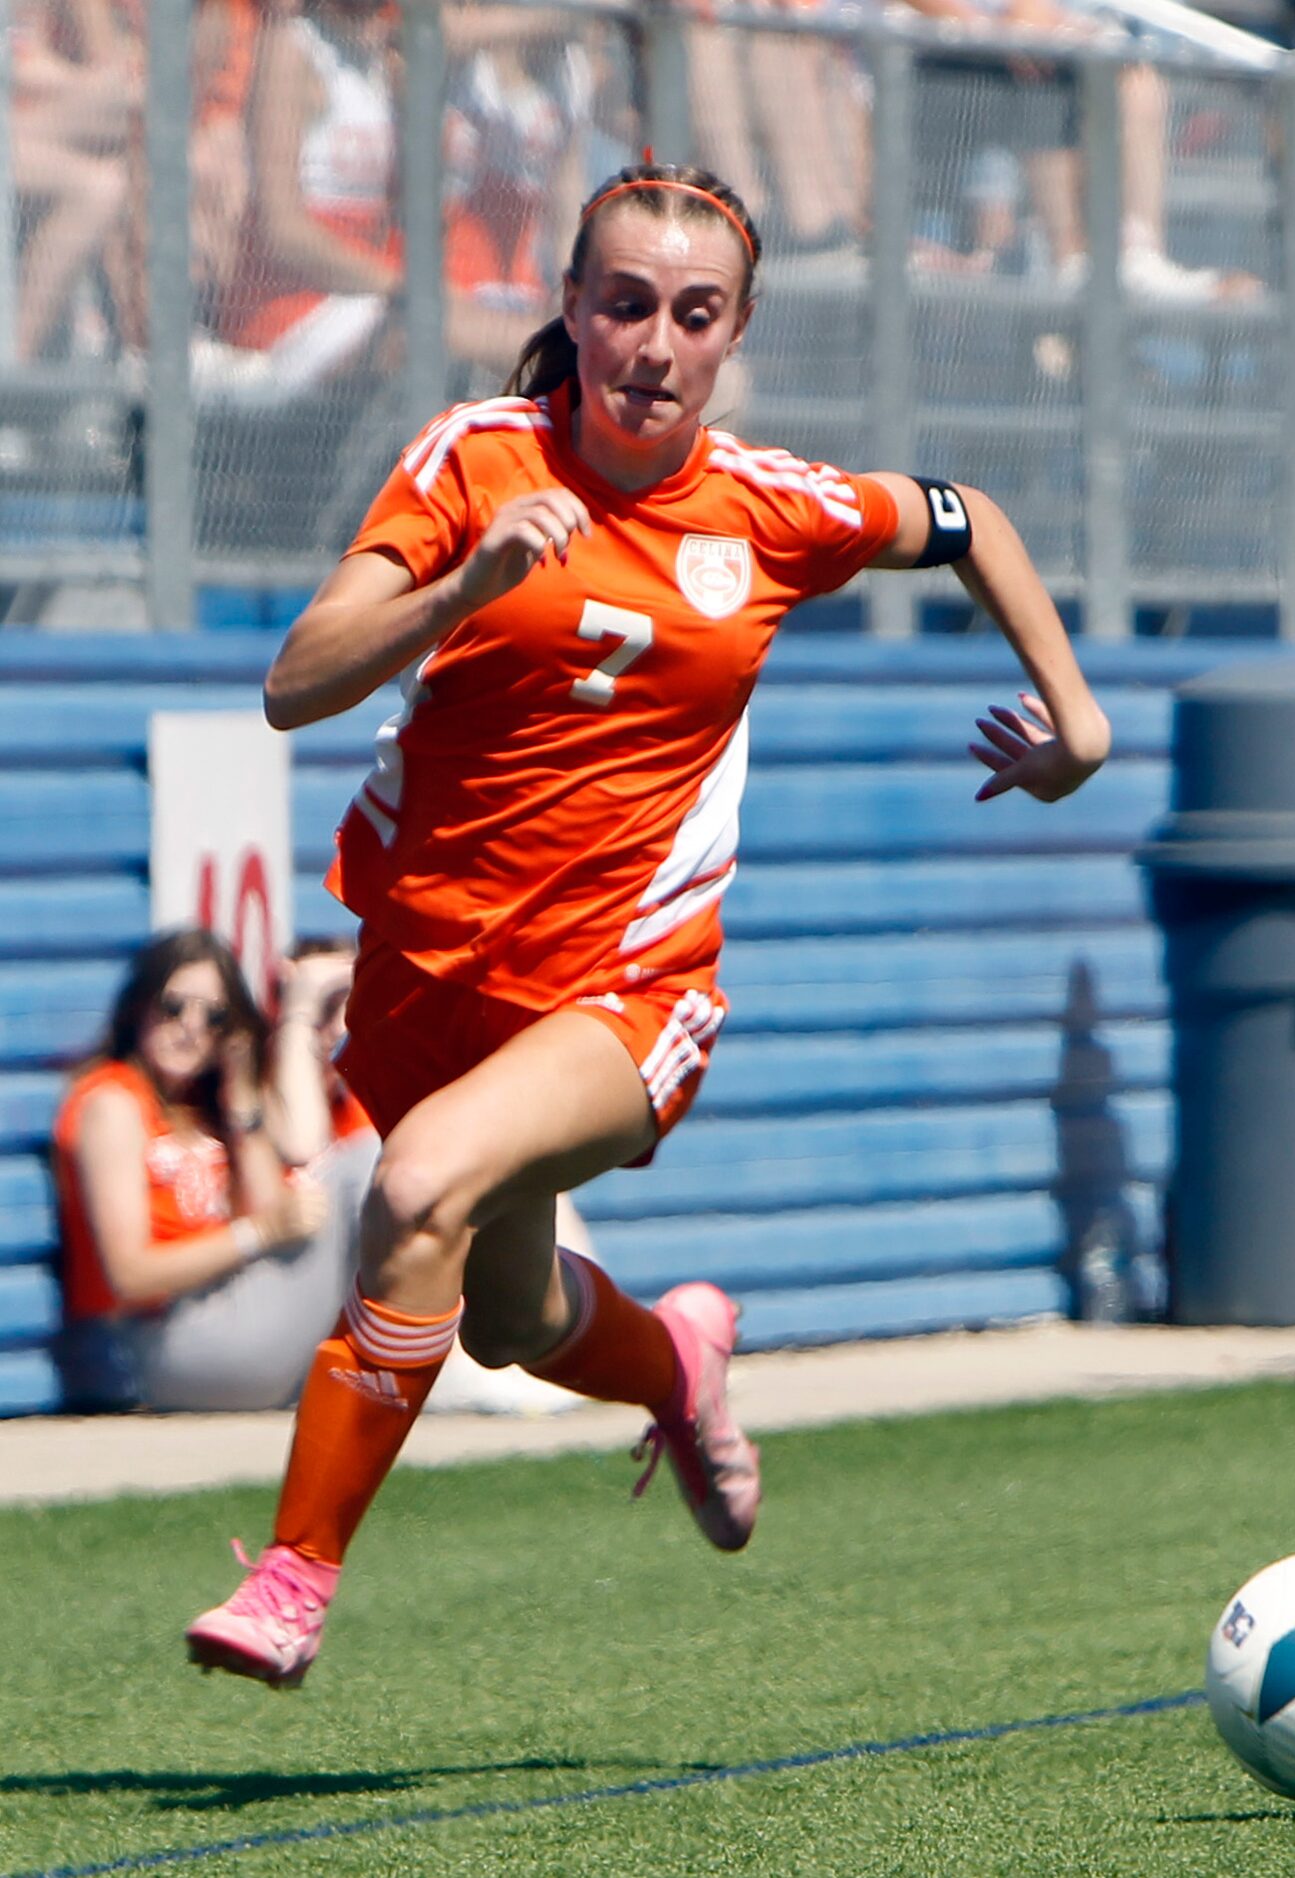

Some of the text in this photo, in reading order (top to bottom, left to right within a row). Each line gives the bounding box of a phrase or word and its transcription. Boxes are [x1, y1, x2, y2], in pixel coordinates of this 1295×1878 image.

[928, 486, 967, 530] C
[688, 540, 740, 558] CELINA
[569, 598, 653, 707] 7
